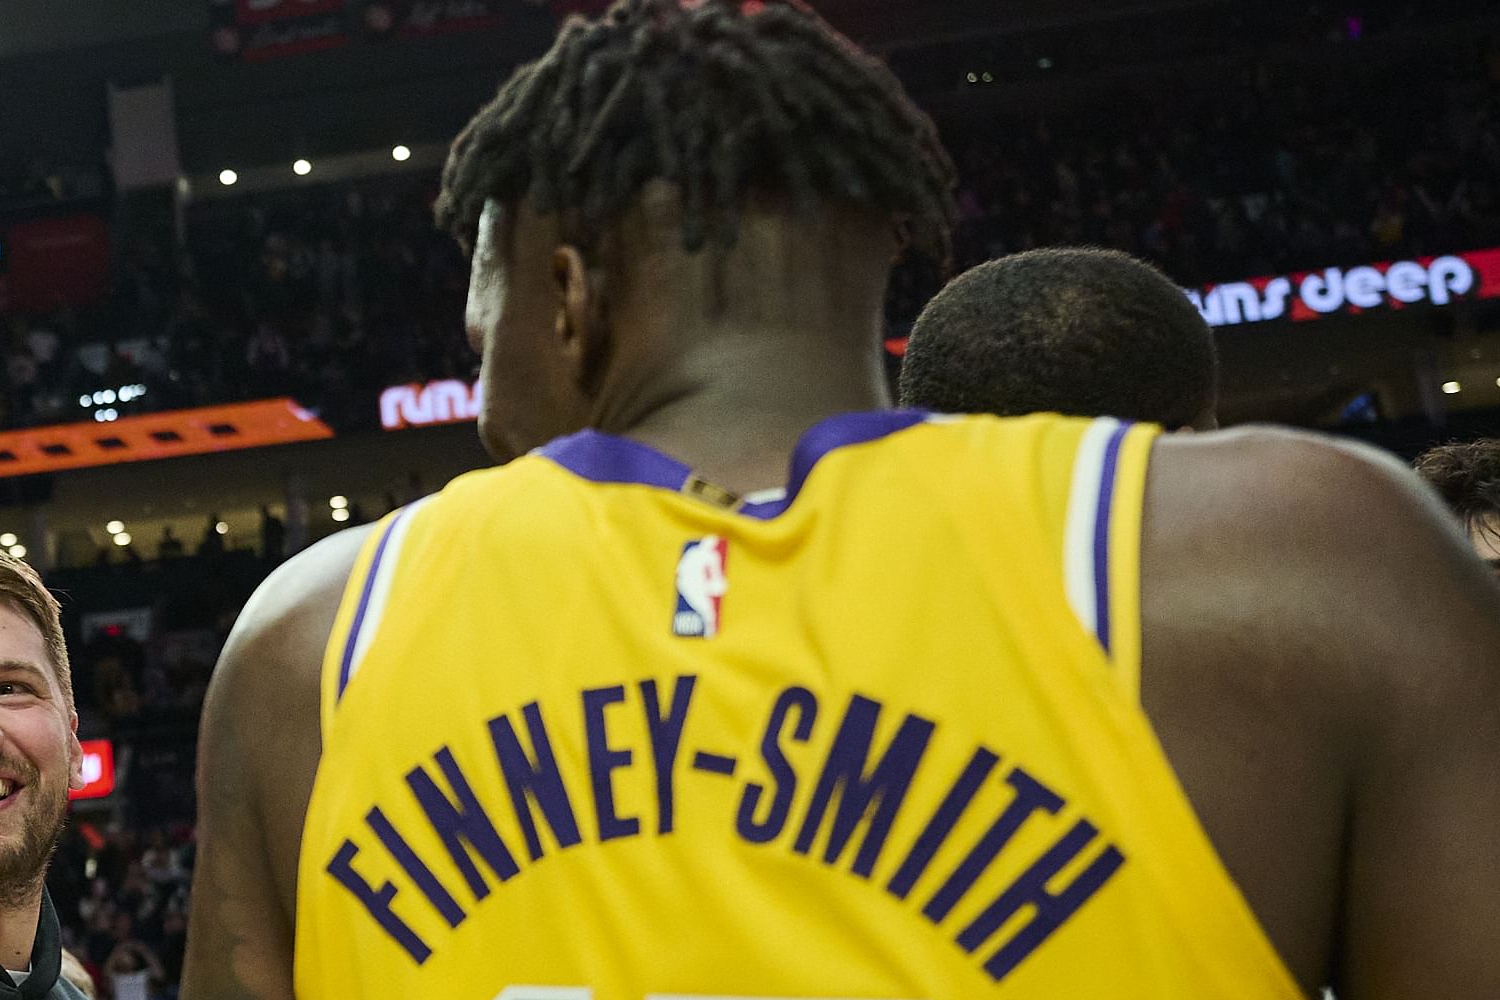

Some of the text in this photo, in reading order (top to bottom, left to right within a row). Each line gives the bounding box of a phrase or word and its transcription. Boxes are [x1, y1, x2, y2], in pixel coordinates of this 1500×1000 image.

[1183, 255, 1474, 328] uns deep
[325, 674, 1125, 984] FINNEY-SMITH
